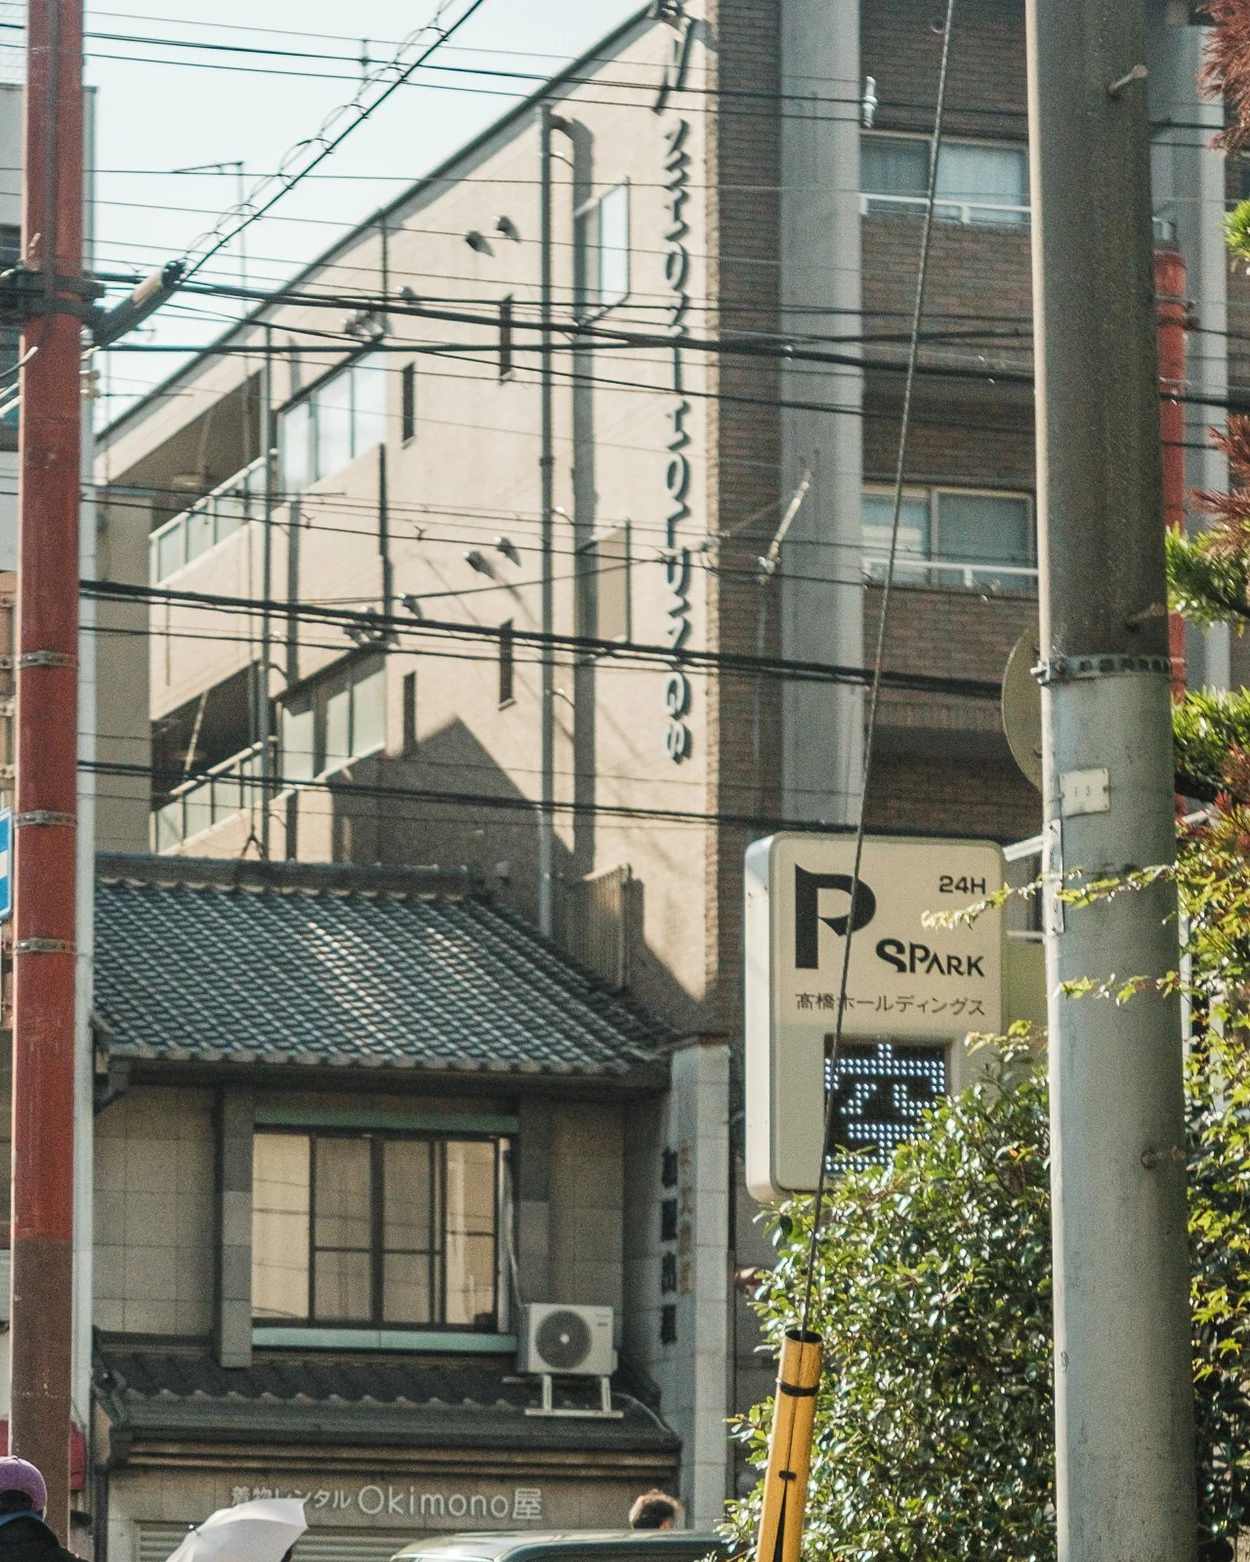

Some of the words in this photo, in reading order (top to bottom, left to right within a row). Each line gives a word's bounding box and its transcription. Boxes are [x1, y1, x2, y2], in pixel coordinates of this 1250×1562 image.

[939, 875, 986, 895] 24H
[875, 938, 985, 977] SPARK
[825, 1043, 945, 1172] 空
